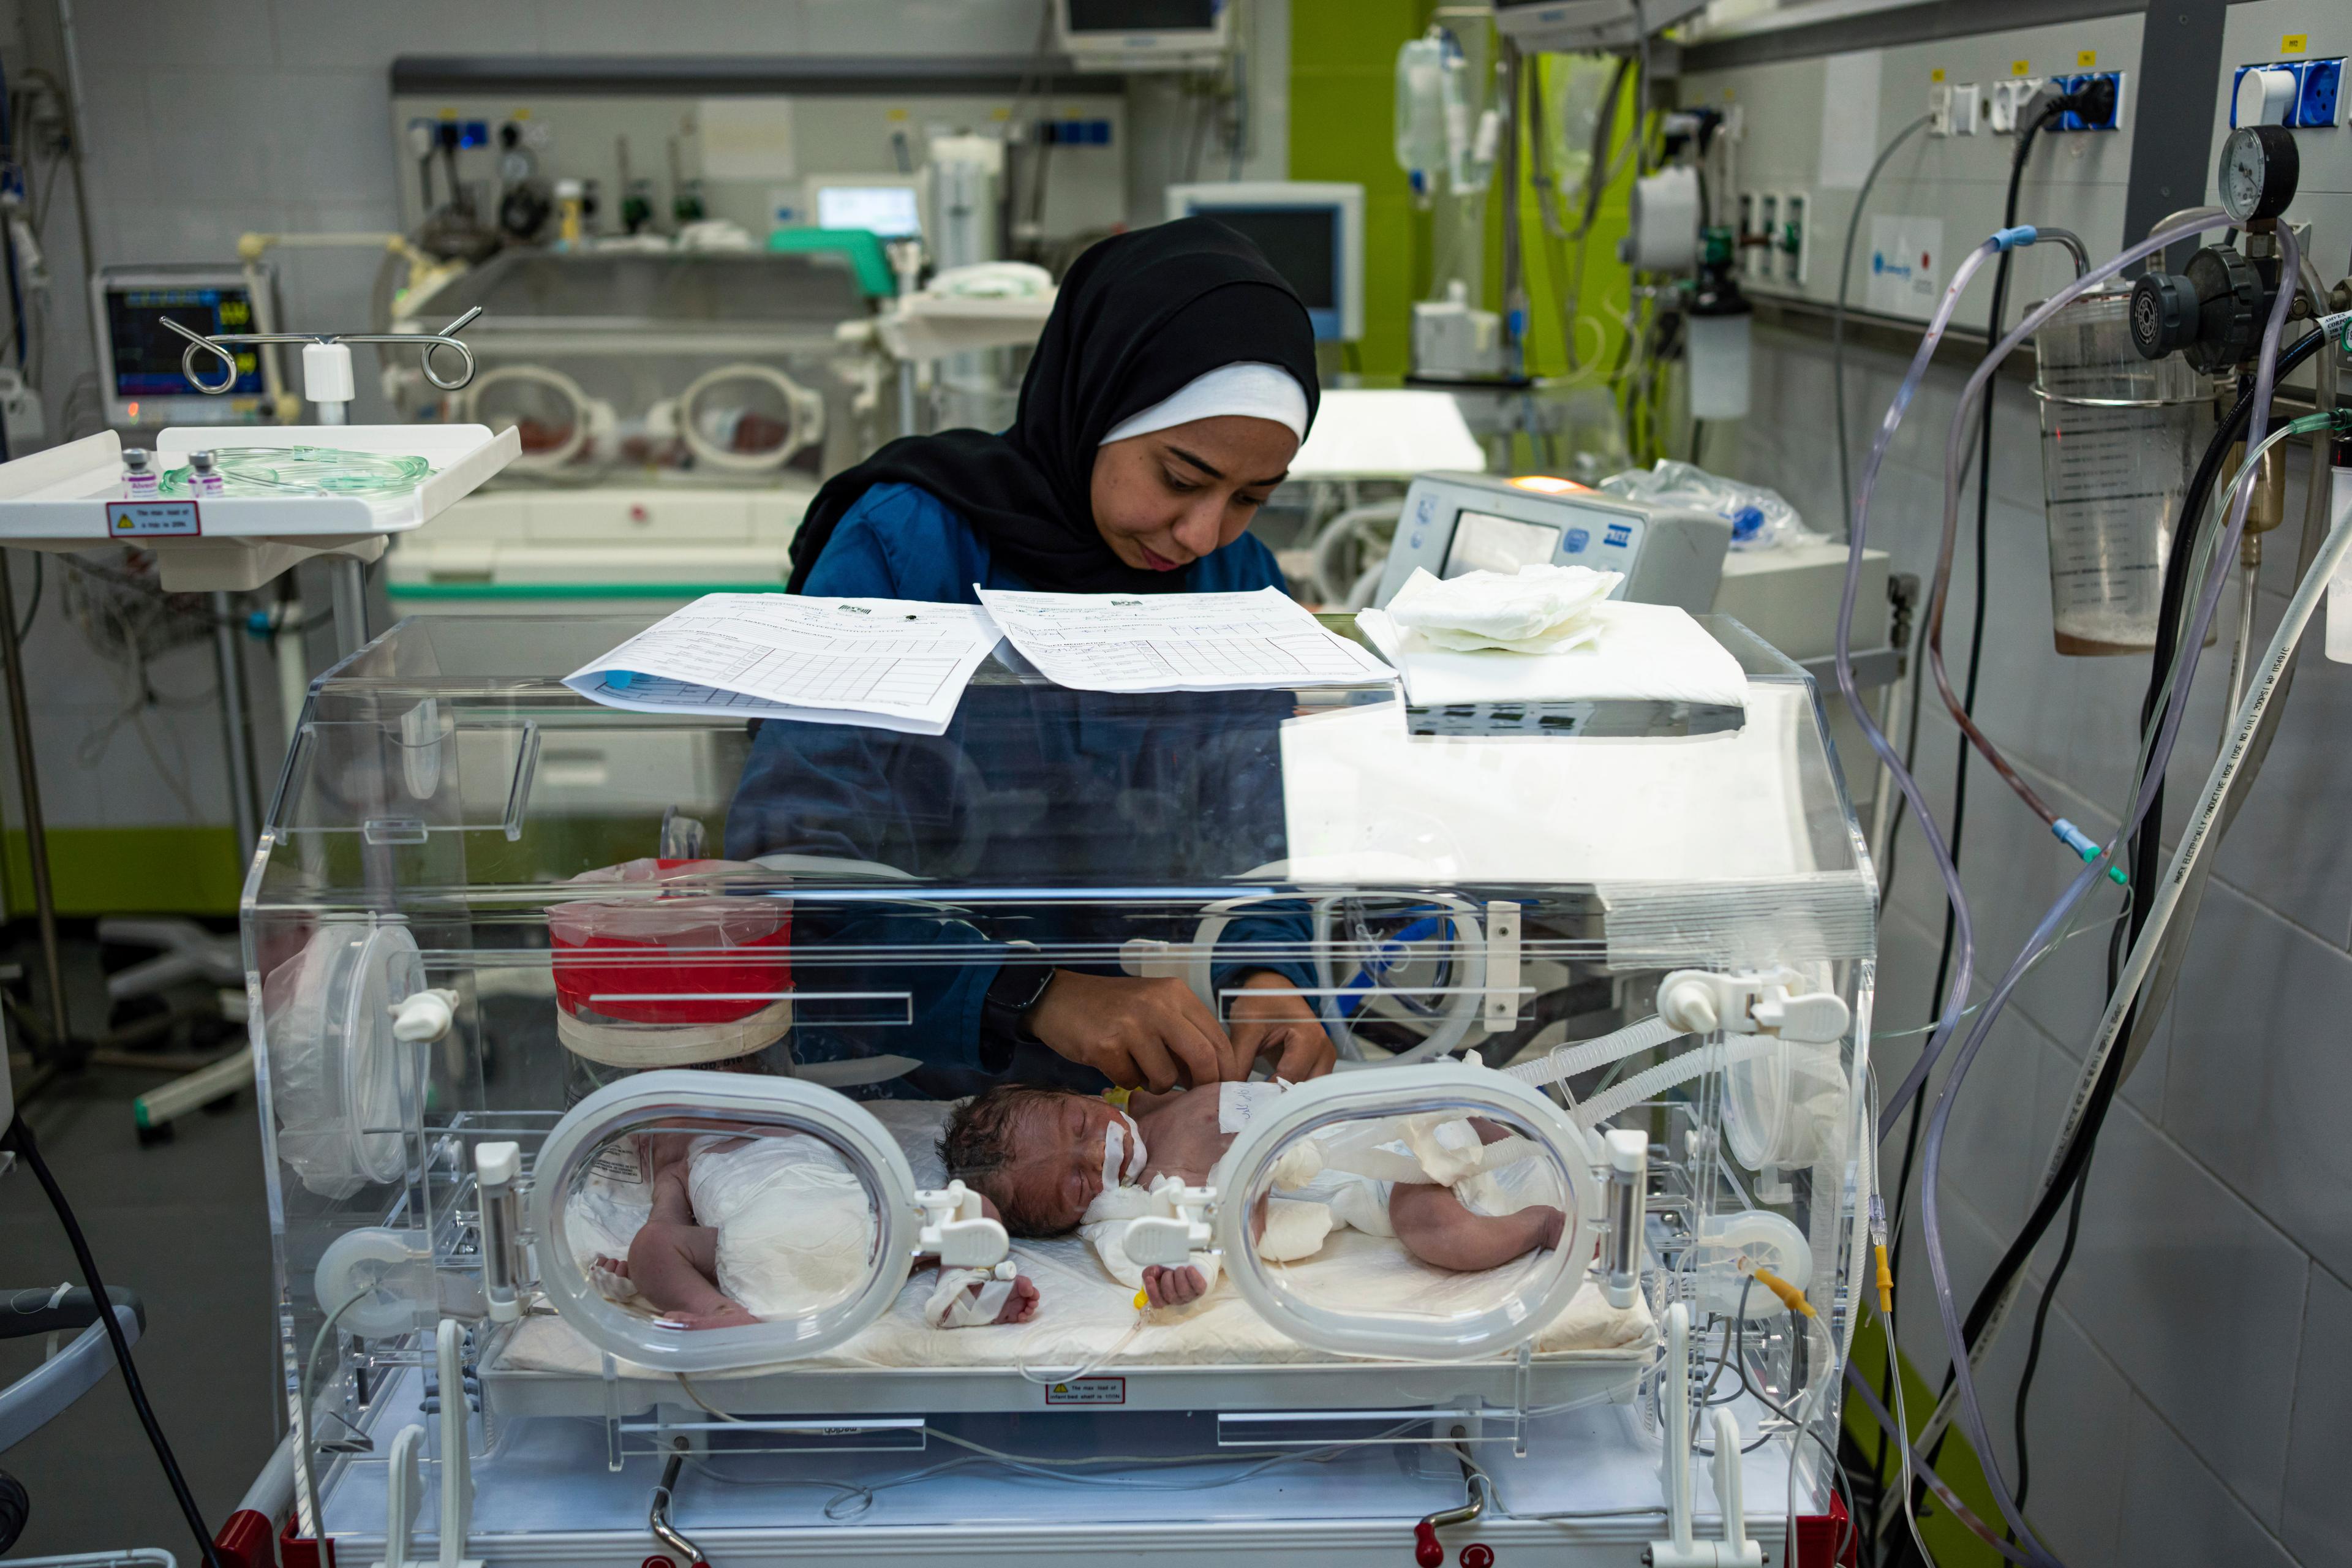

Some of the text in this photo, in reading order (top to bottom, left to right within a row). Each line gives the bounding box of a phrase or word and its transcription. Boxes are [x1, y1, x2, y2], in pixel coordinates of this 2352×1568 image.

[2325, 313, 2346, 323] AMVEX
[2203, 780, 2225, 820] CONDUCTIVE
[2222, 761, 2234, 779] HOSE
[2239, 731, 2248, 742] NO
[2266, 674, 2274, 685] WP
